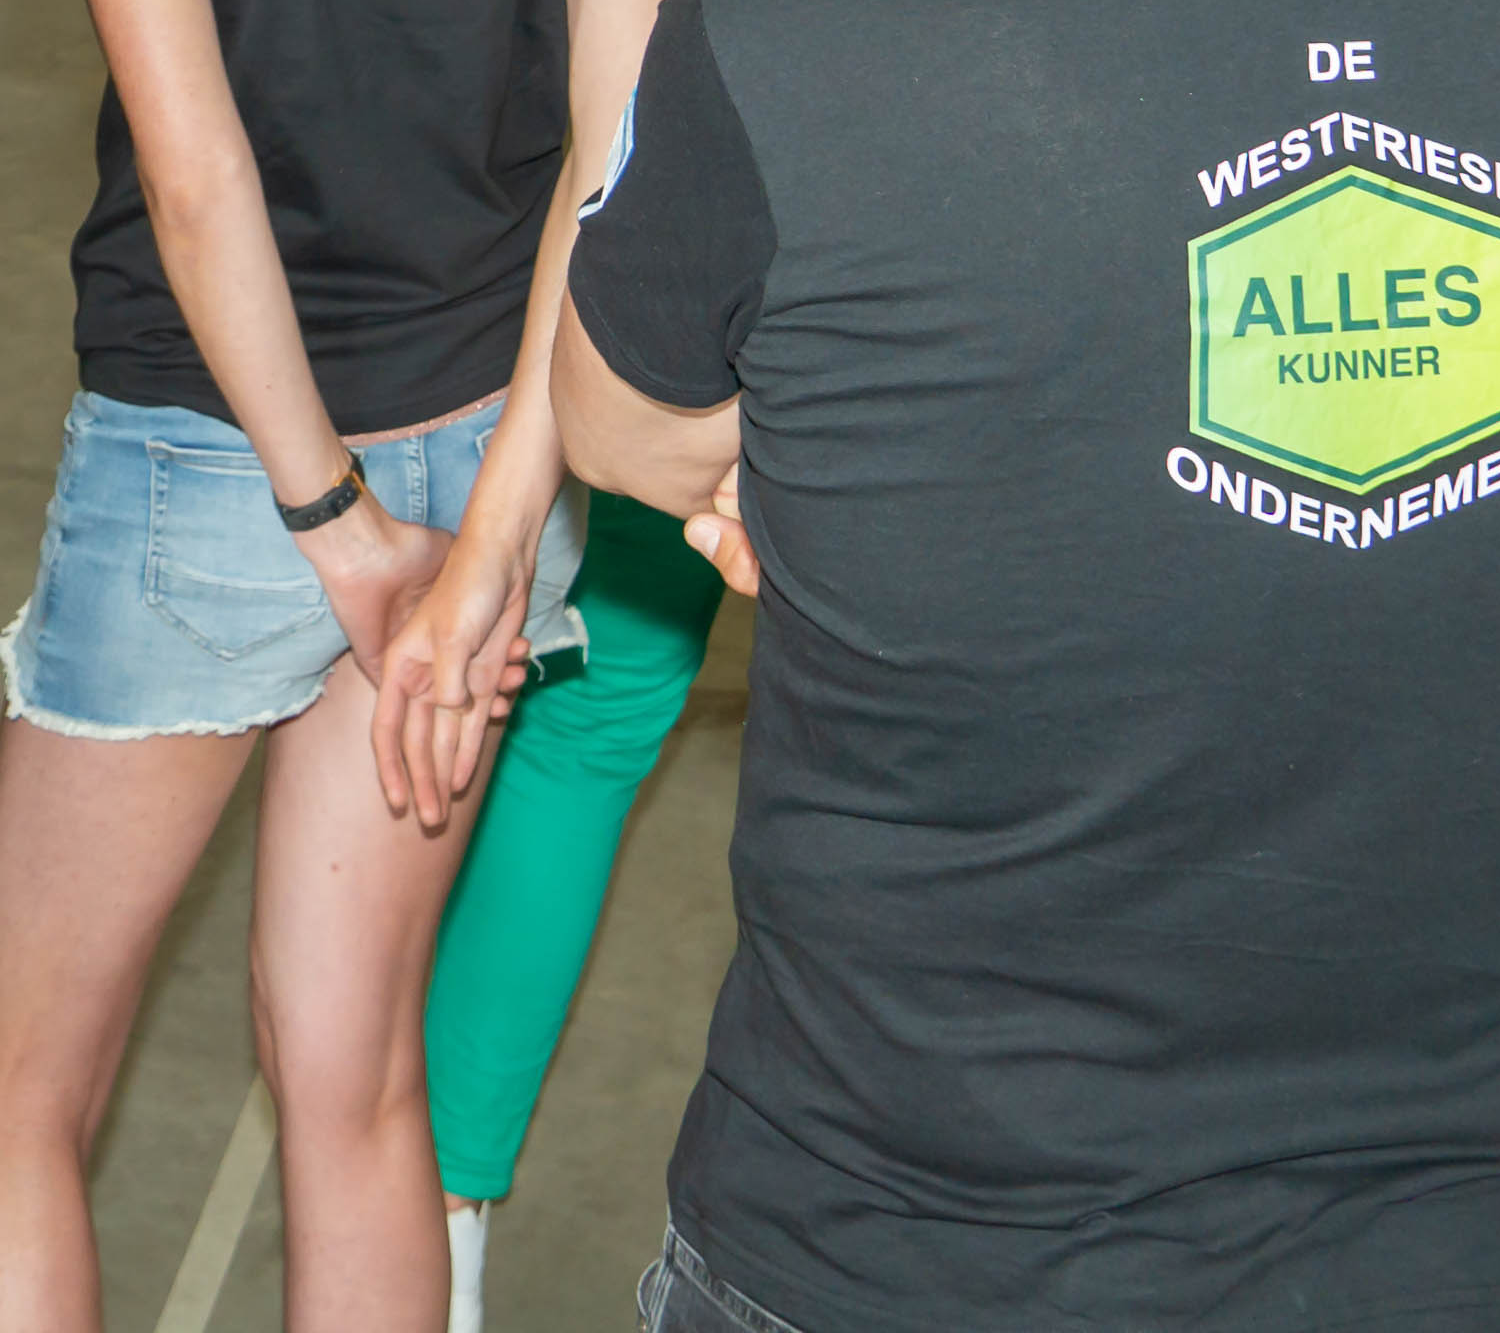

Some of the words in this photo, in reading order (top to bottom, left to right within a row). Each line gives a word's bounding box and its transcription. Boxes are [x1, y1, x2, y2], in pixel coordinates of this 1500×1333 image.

[1307, 40, 1376, 83] DE
[1231, 264, 1482, 339] ALLES
[1277, 344, 1442, 385] KUNNER
